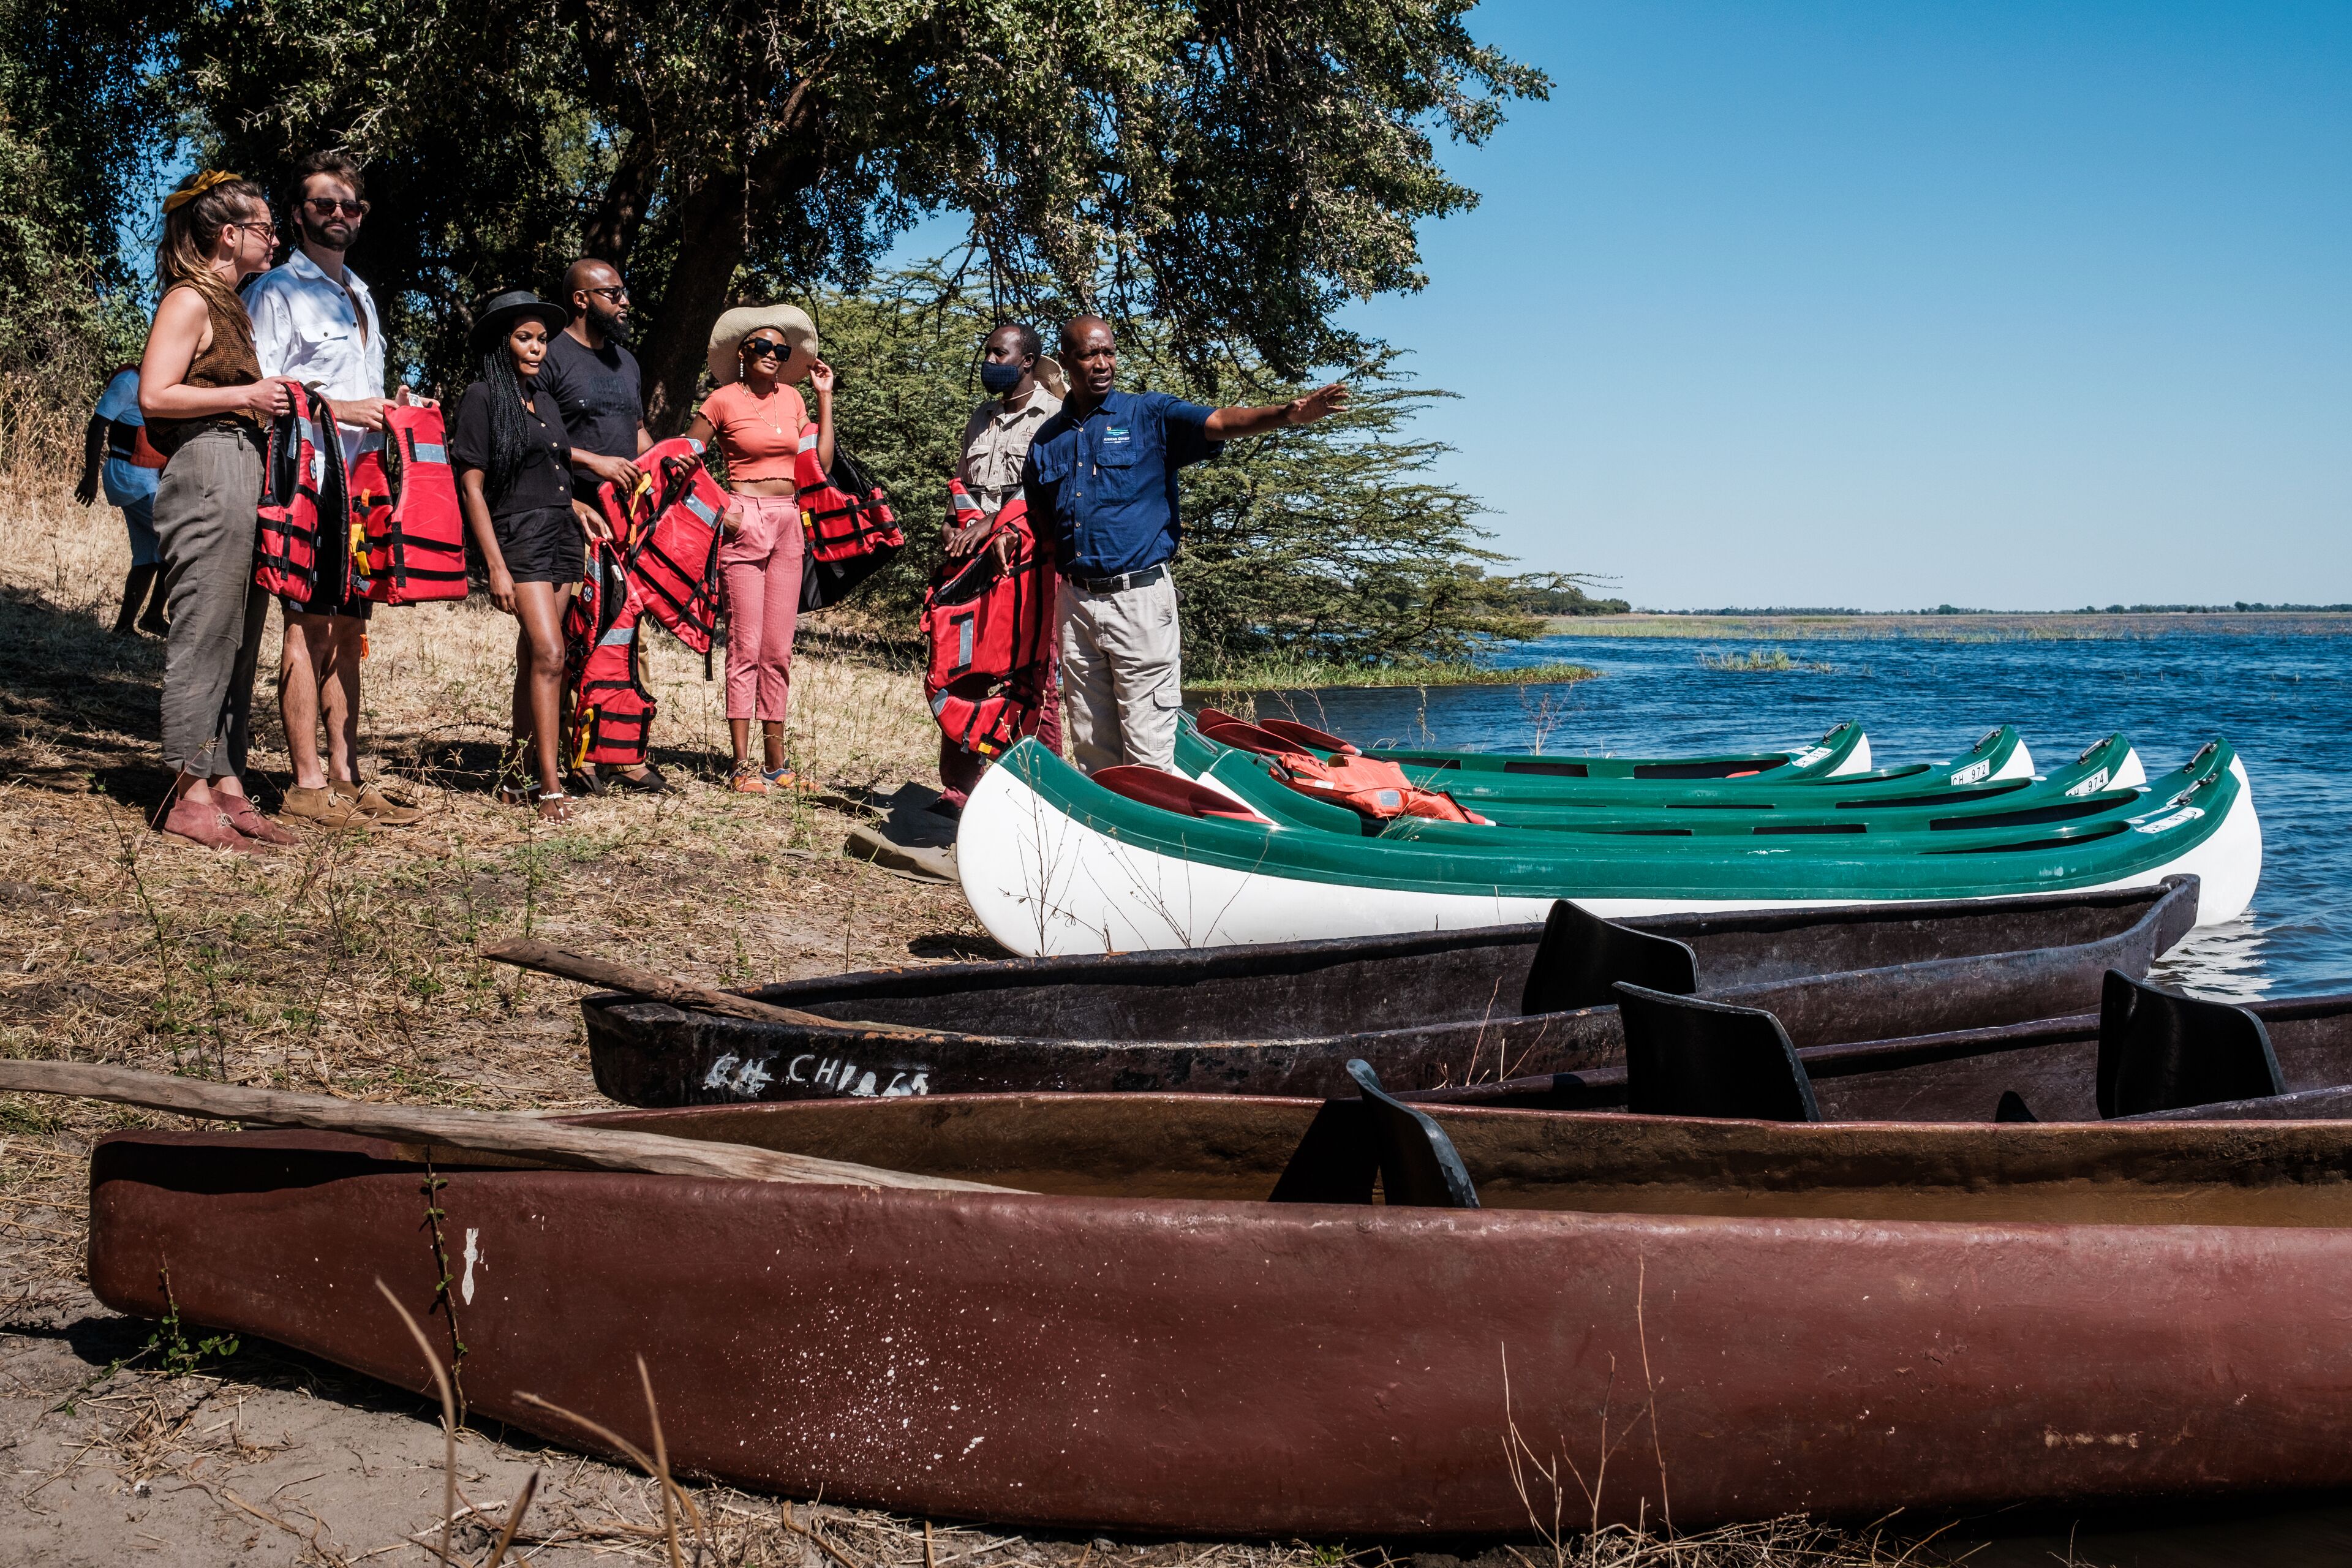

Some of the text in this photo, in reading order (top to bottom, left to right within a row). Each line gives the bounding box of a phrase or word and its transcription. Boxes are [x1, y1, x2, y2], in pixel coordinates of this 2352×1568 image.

[1953, 764, 1986, 785] CH 972
[2068, 773, 2103, 796] H 974
